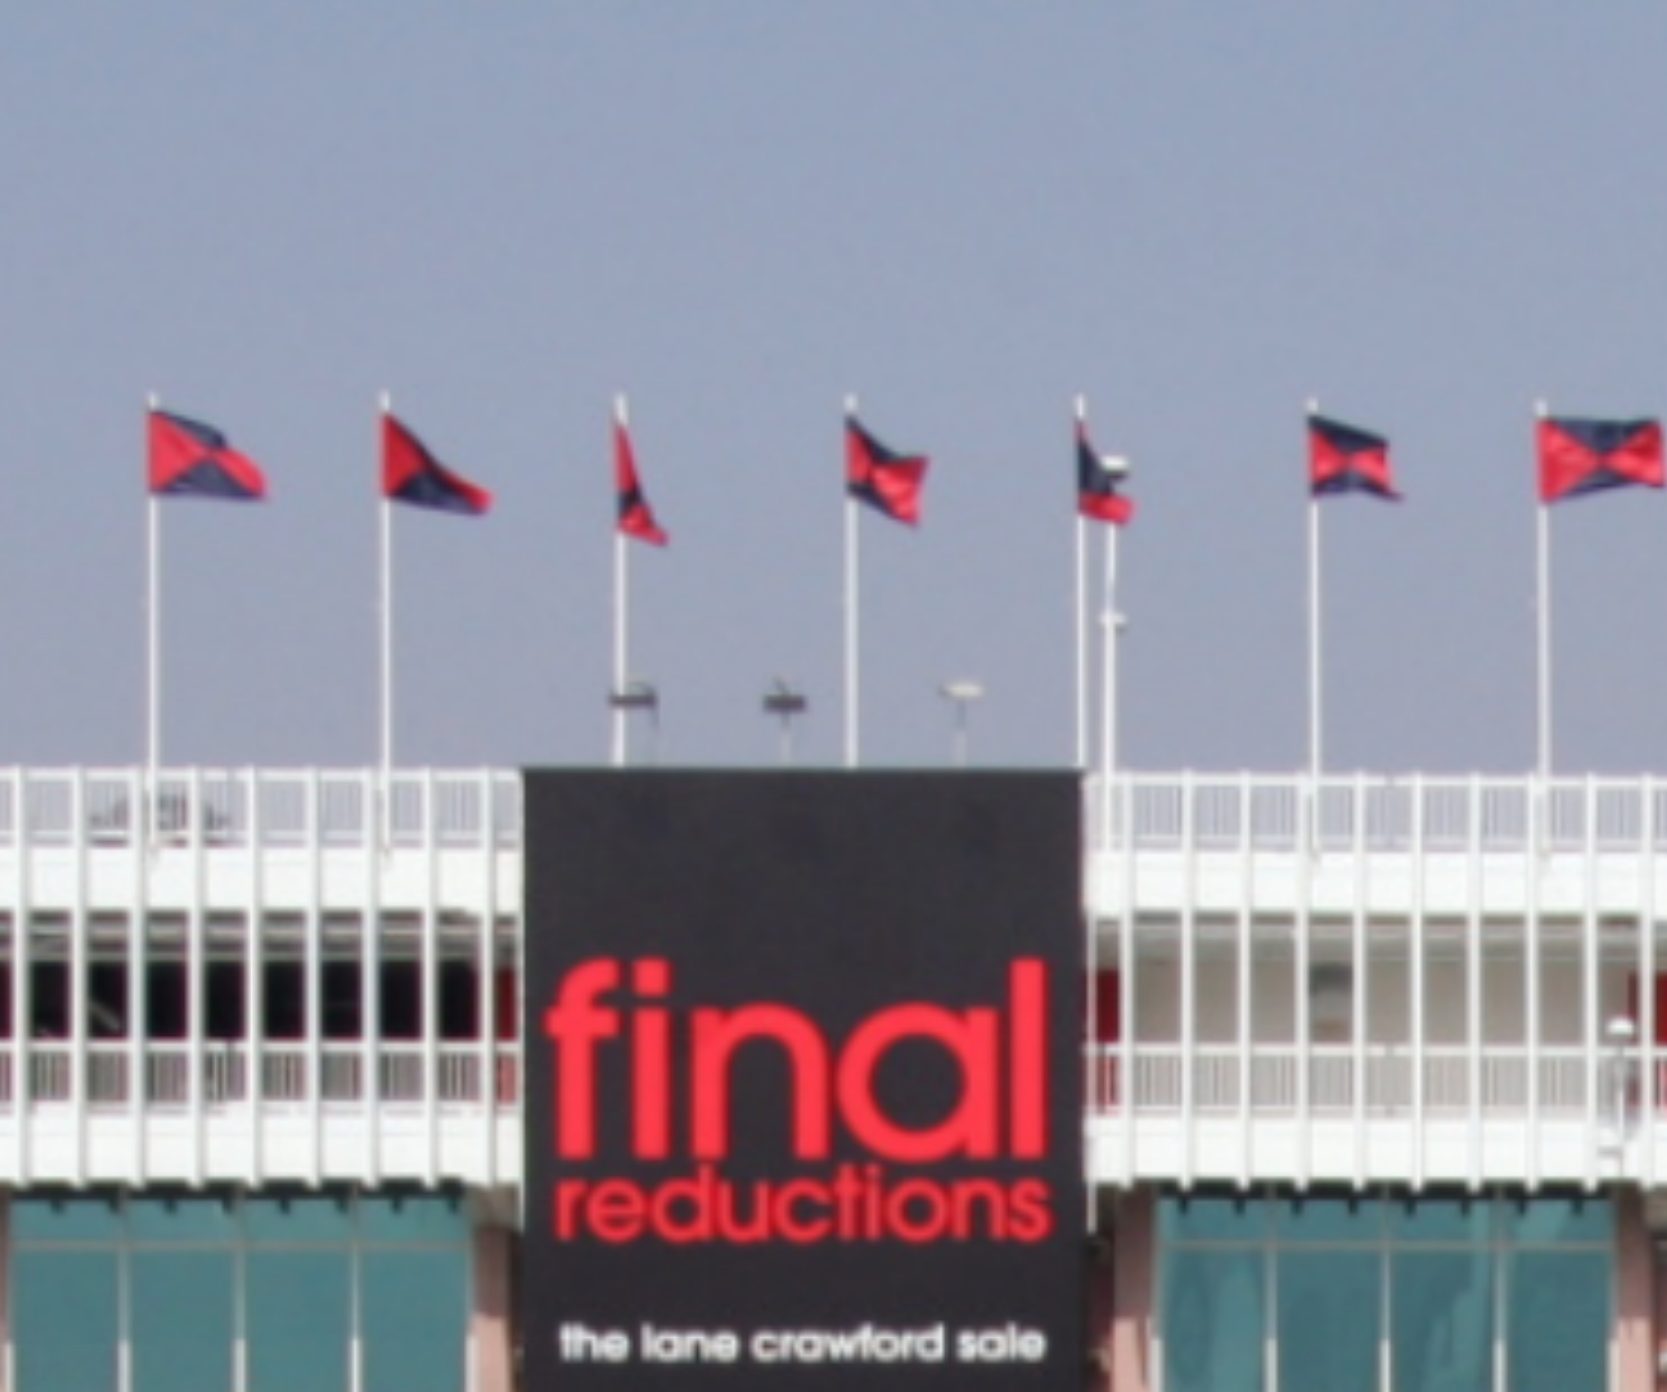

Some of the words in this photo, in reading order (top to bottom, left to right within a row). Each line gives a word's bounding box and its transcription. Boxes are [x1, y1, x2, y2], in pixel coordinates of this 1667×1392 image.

[544, 958, 1049, 1163] final
[554, 1164, 1055, 1243] reductions
[559, 1323, 630, 1362] the
[641, 1324, 740, 1362] lane
[750, 1323, 945, 1362] crawford
[957, 1324, 1048, 1362] sale
